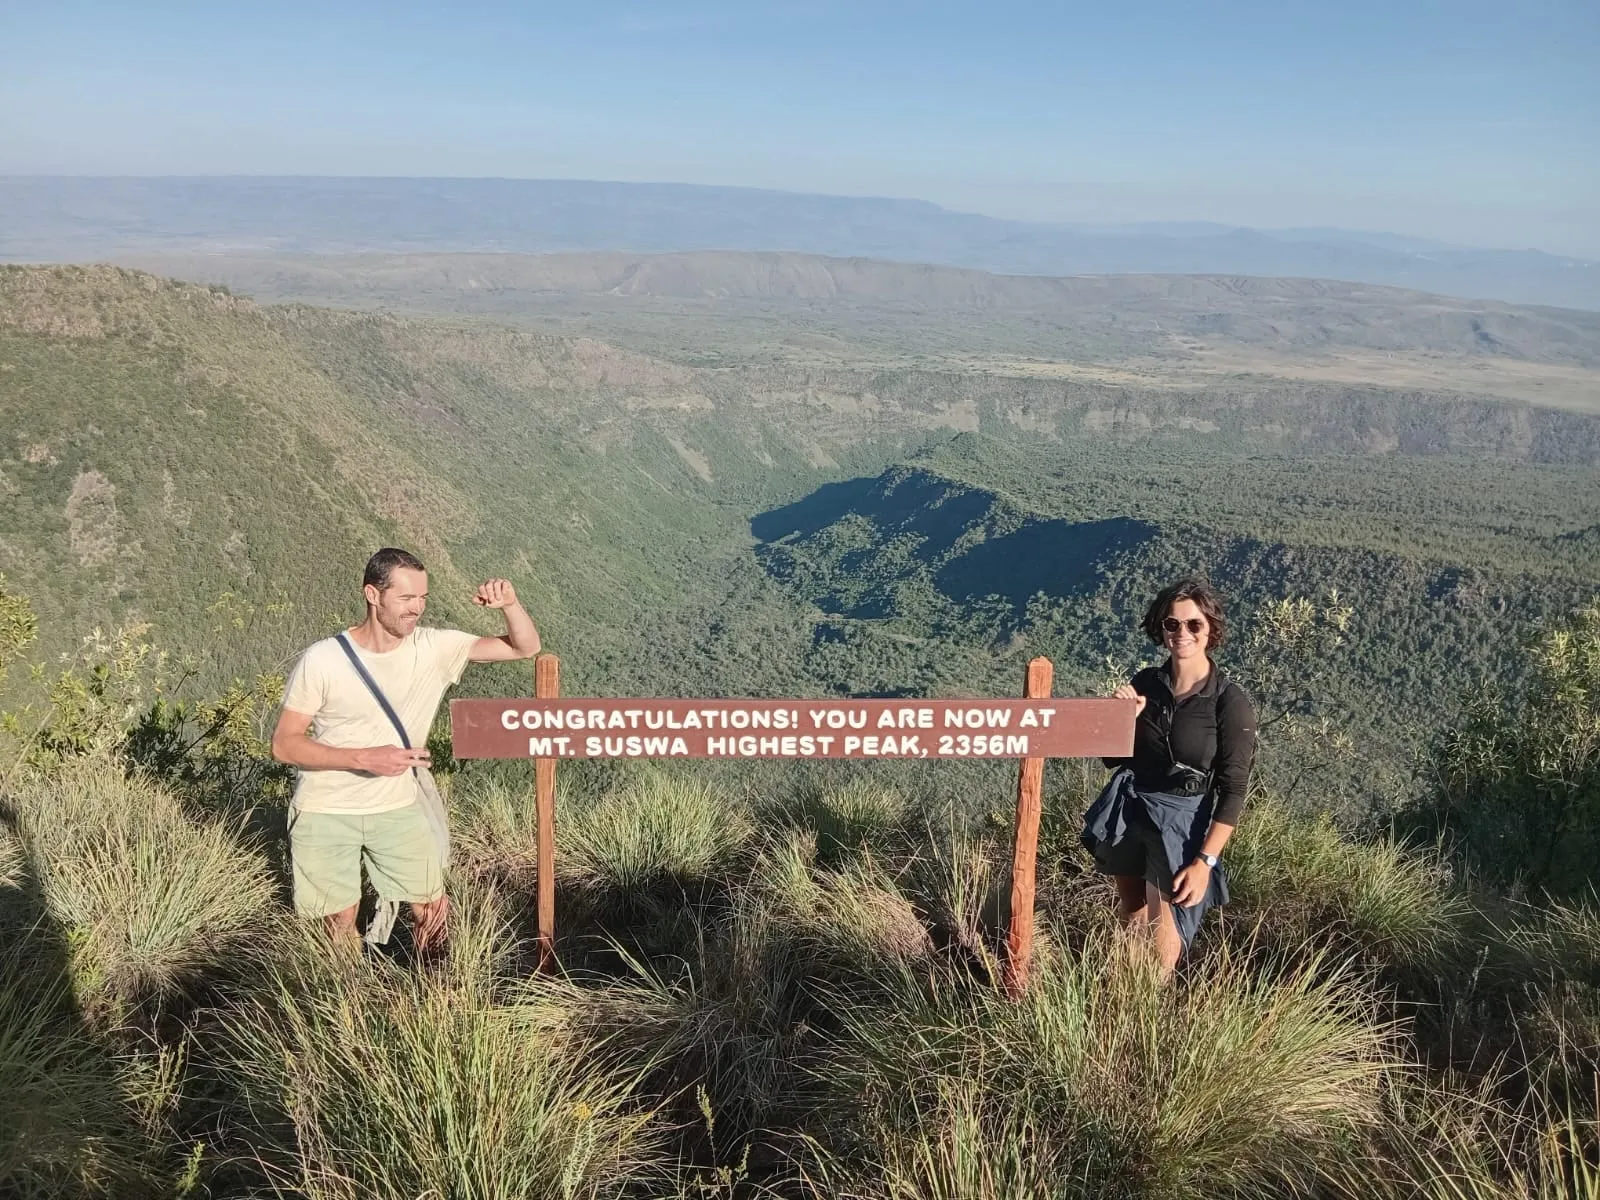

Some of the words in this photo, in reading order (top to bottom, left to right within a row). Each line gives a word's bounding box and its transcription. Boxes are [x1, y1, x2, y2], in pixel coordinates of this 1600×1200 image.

[501, 709, 798, 730] CONGRATULATIONS!
[809, 709, 867, 729] YOU
[877, 708, 934, 729] ARE
[944, 708, 1012, 728] NOW
[1019, 708, 1057, 728] AT
[529, 736, 576, 756] MT.
[585, 736, 689, 757] SUSWA
[707, 736, 835, 757] HIGHEST
[844, 735, 929, 759] PEAK,
[938, 735, 1029, 756] 2356M
